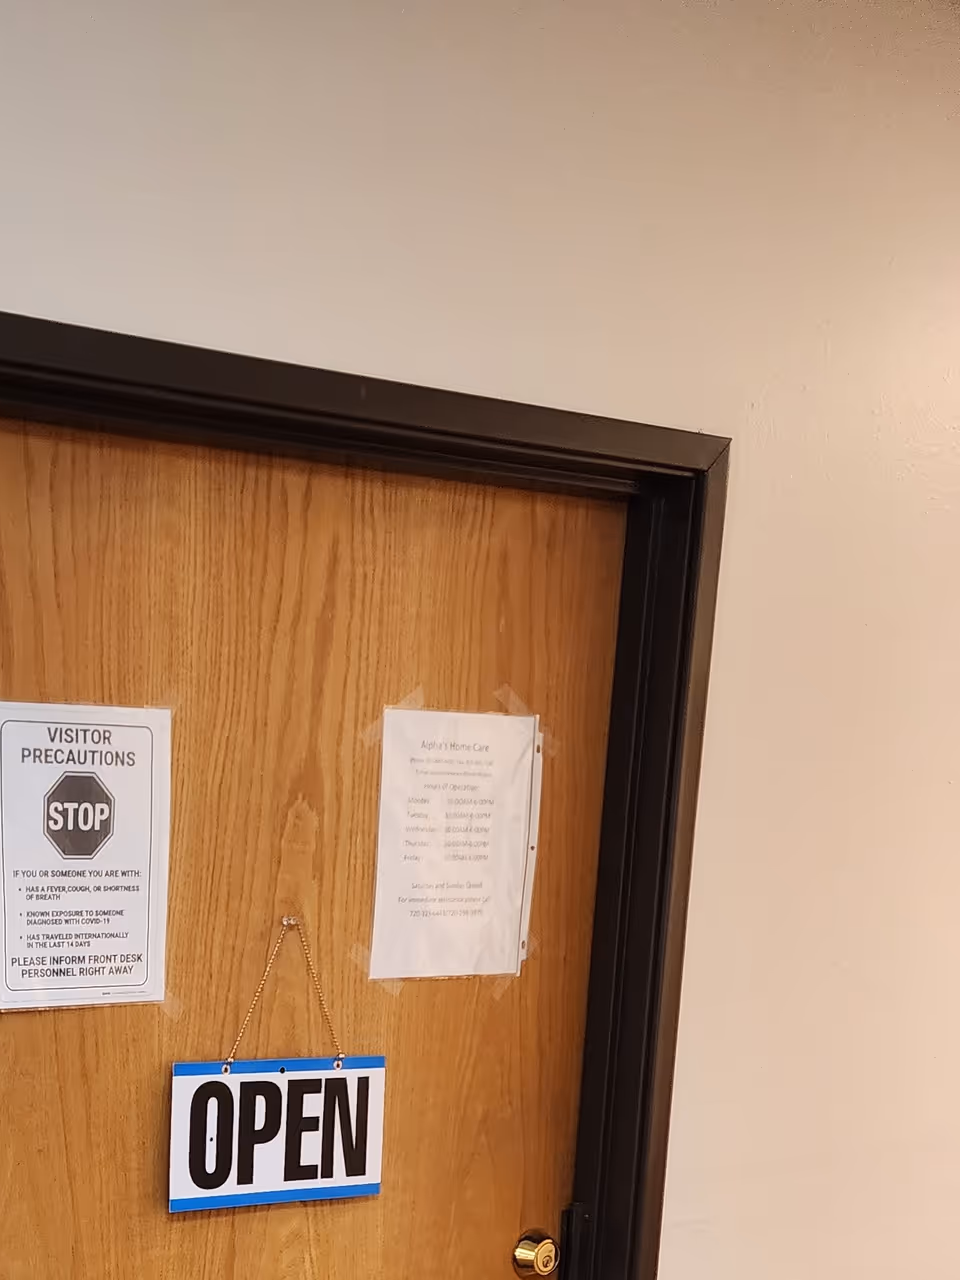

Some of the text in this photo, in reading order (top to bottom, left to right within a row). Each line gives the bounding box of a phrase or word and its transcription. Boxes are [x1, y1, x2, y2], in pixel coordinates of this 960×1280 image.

[47, 727, 112, 746] VISITOR
[421, 740, 490, 752] Alpha's Home Care
[21, 748, 136, 766] PRECAUTIONS
[48, 801, 109, 831] STOP
[13, 870, 142, 878] IF YOU OR SOMEONE YOU ARE WITH:
[26, 918, 63, 926] DIAGNOSED
[74, 932, 129, 940] INTERNATIONALLY
[11, 953, 143, 967] PLEASE INFORM FRONT DESK
[21, 965, 134, 979] PERSONNEL RIGHT AWAY
[188, 1076, 369, 1190] OPEN
